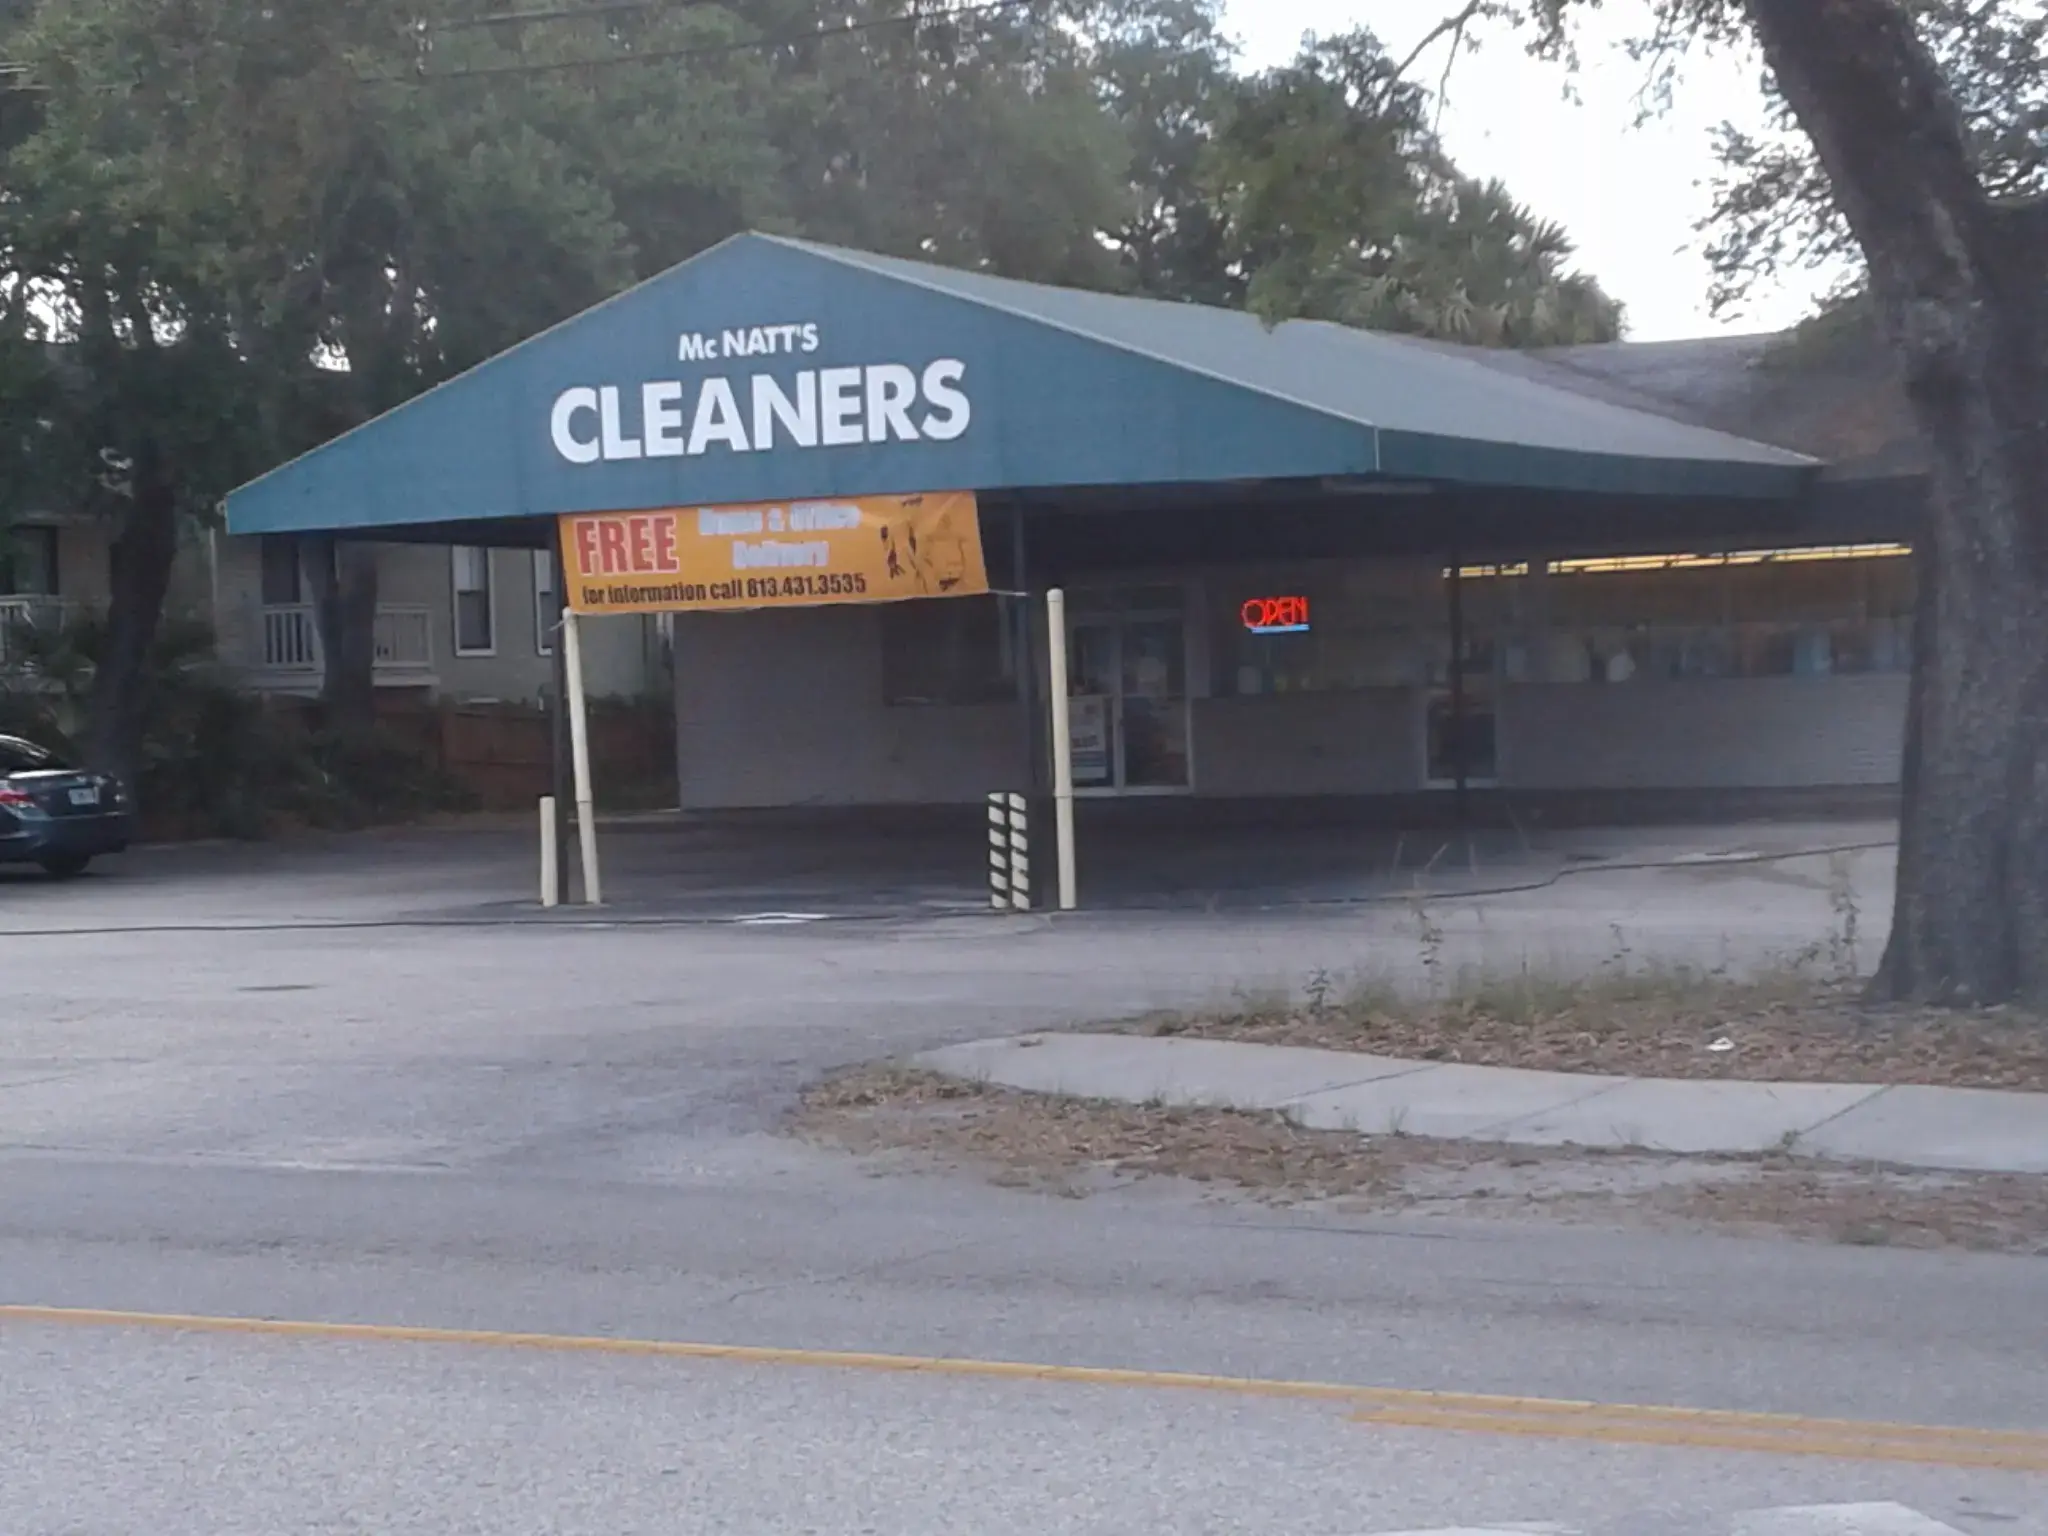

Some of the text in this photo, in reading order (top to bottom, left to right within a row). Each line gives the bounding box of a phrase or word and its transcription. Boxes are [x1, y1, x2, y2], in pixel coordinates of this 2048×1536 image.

[722, 322, 819, 357] NATT'S
[551, 358, 970, 463] CLEANERS
[574, 514, 680, 576] FREE
[582, 572, 867, 604] for information call 813.431.3535
[1241, 596, 1308, 626] OPEN
